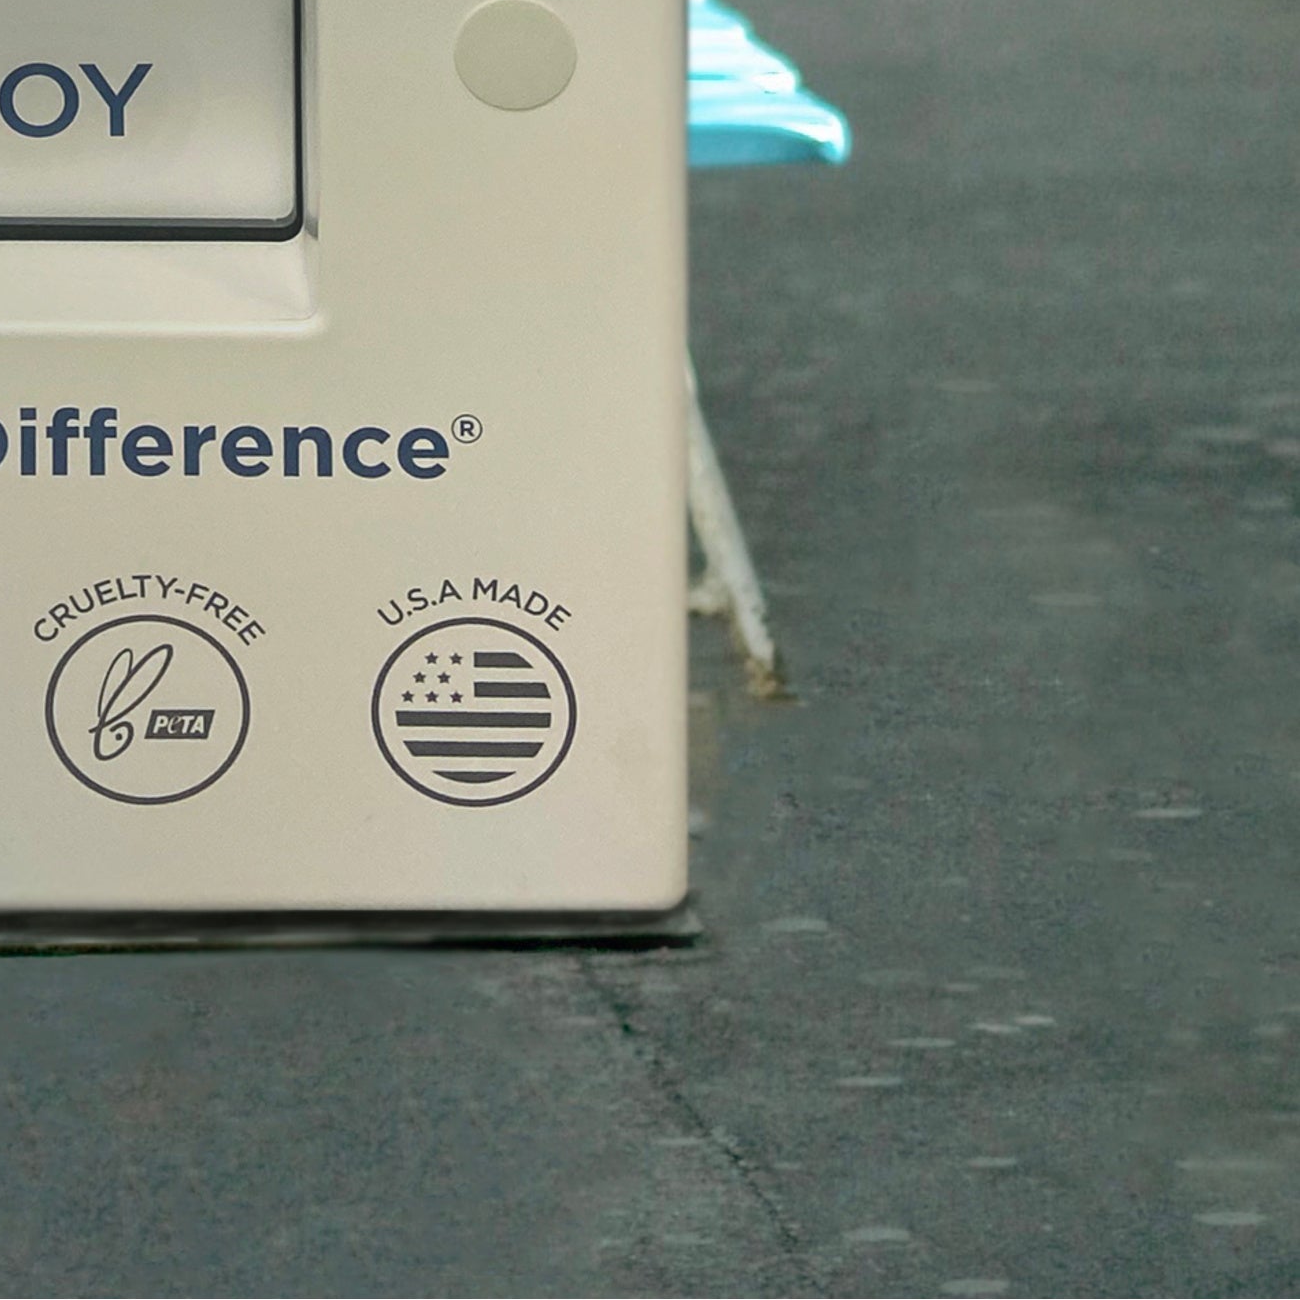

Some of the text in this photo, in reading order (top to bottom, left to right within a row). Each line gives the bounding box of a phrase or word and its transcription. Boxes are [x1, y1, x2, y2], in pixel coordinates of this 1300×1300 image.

[33, 575, 266, 647] CRUELTY-FREE
[378, 577, 572, 630] U.S.A MADE
